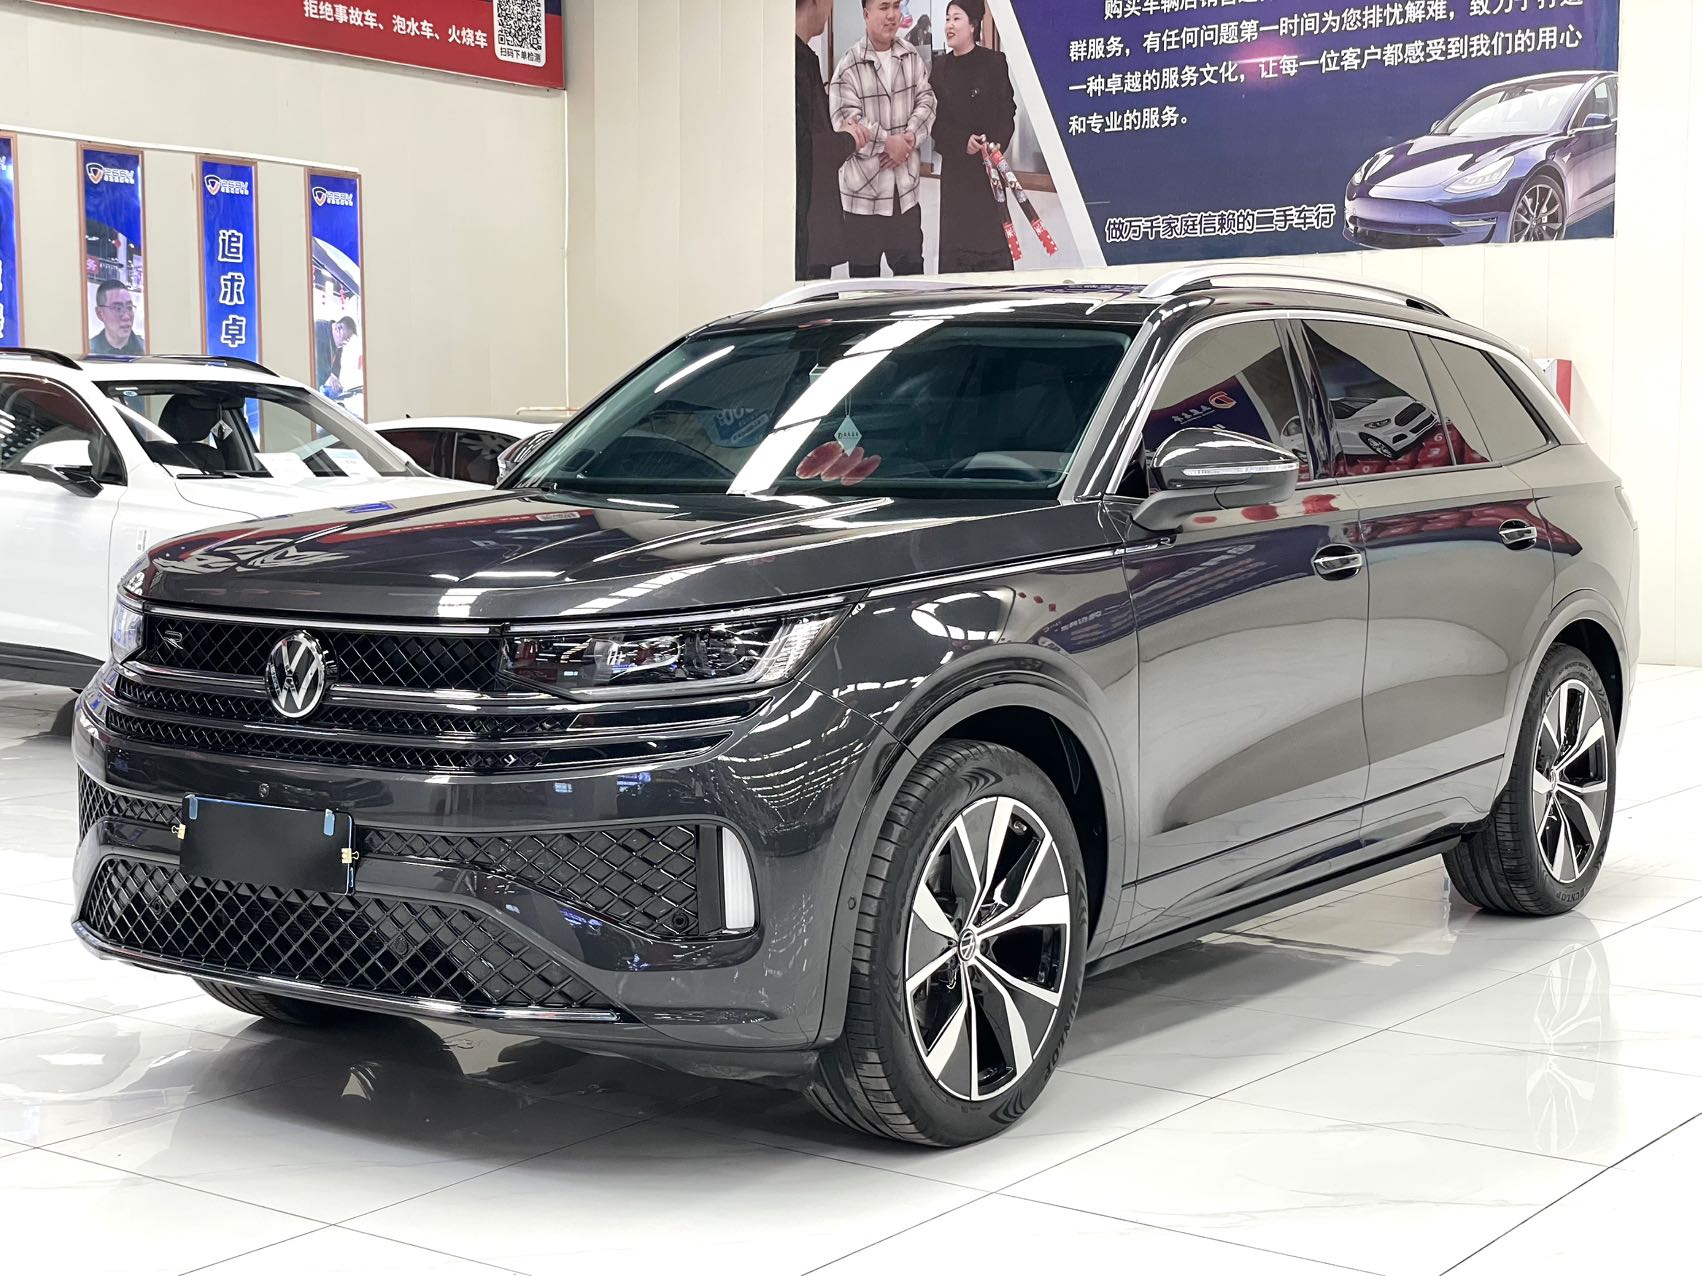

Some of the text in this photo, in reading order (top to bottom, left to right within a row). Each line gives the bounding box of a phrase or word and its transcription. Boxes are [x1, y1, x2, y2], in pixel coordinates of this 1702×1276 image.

[303, 0, 488, 49] 拒绝事故车、泡水车、火烧车
[1069, 0, 1584, 62] 群服务，有任何问题第一时间为您排忧解难，致力于
[1068, 24, 1582, 98] 一种卓越的服务文化，让每一位客户都感受到我们的用心
[1068, 105, 1190, 136] 和专业的服务。
[1105, 203, 1336, 243] 做万千家庭信赖的二手车行
[218, 230, 246, 347] 追求卓
